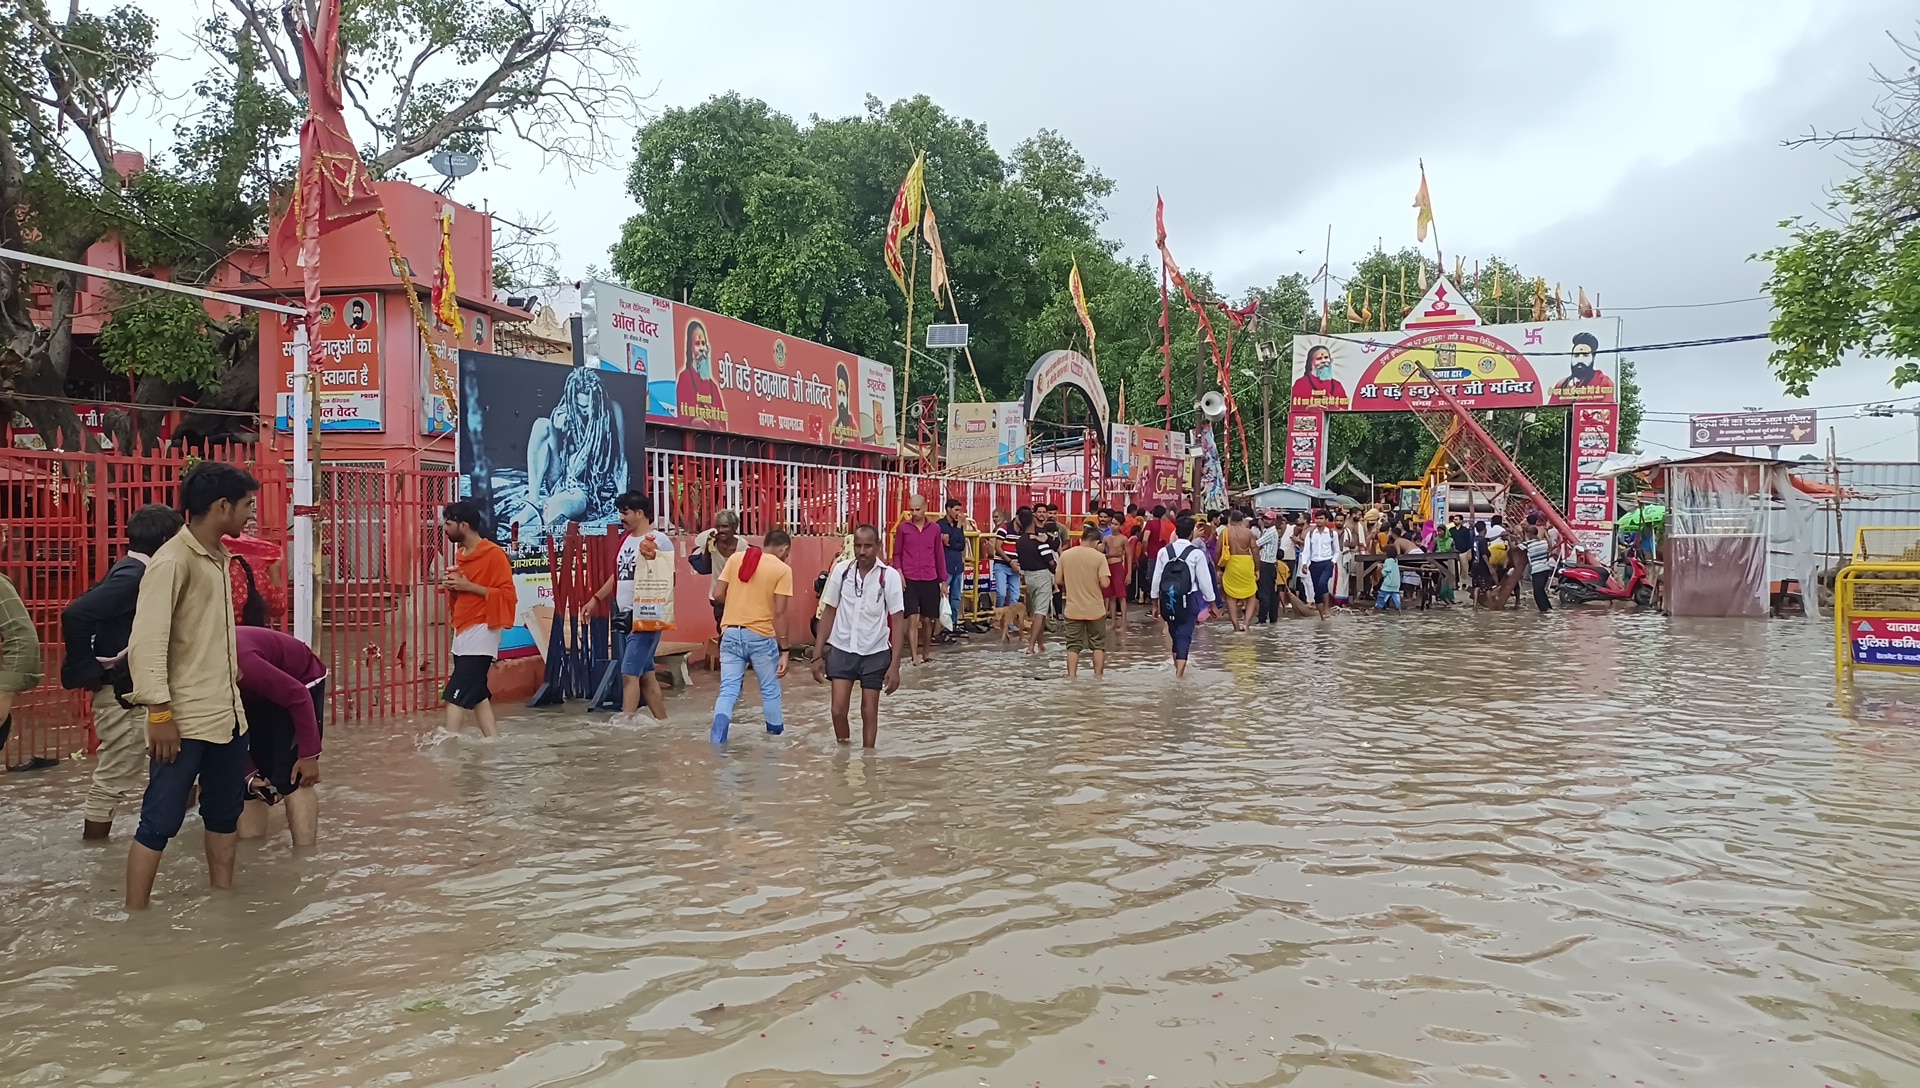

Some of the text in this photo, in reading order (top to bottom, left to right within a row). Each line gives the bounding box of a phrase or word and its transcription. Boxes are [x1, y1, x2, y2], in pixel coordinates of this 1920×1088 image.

[653, 297, 670, 310] PRISM
[612, 311, 659, 338] ऑल वेदर
[356, 338, 372, 354] का
[322, 362, 369, 386] स्वागत है
[718, 352, 832, 410] श्री बड़े हनुमान जी मन्दिर
[1360, 384, 1379, 398] श्री
[1382, 384, 1402, 400] बड़े
[1408, 384, 1458, 399] हनुमन
[1462, 381, 1485, 395] जी
[1489, 379, 1534, 394] मन्दिर
[84, 409, 99, 427] जी
[337, 404, 359, 417] वेदर
[1857, 635, 1890, 651] पुलिस
